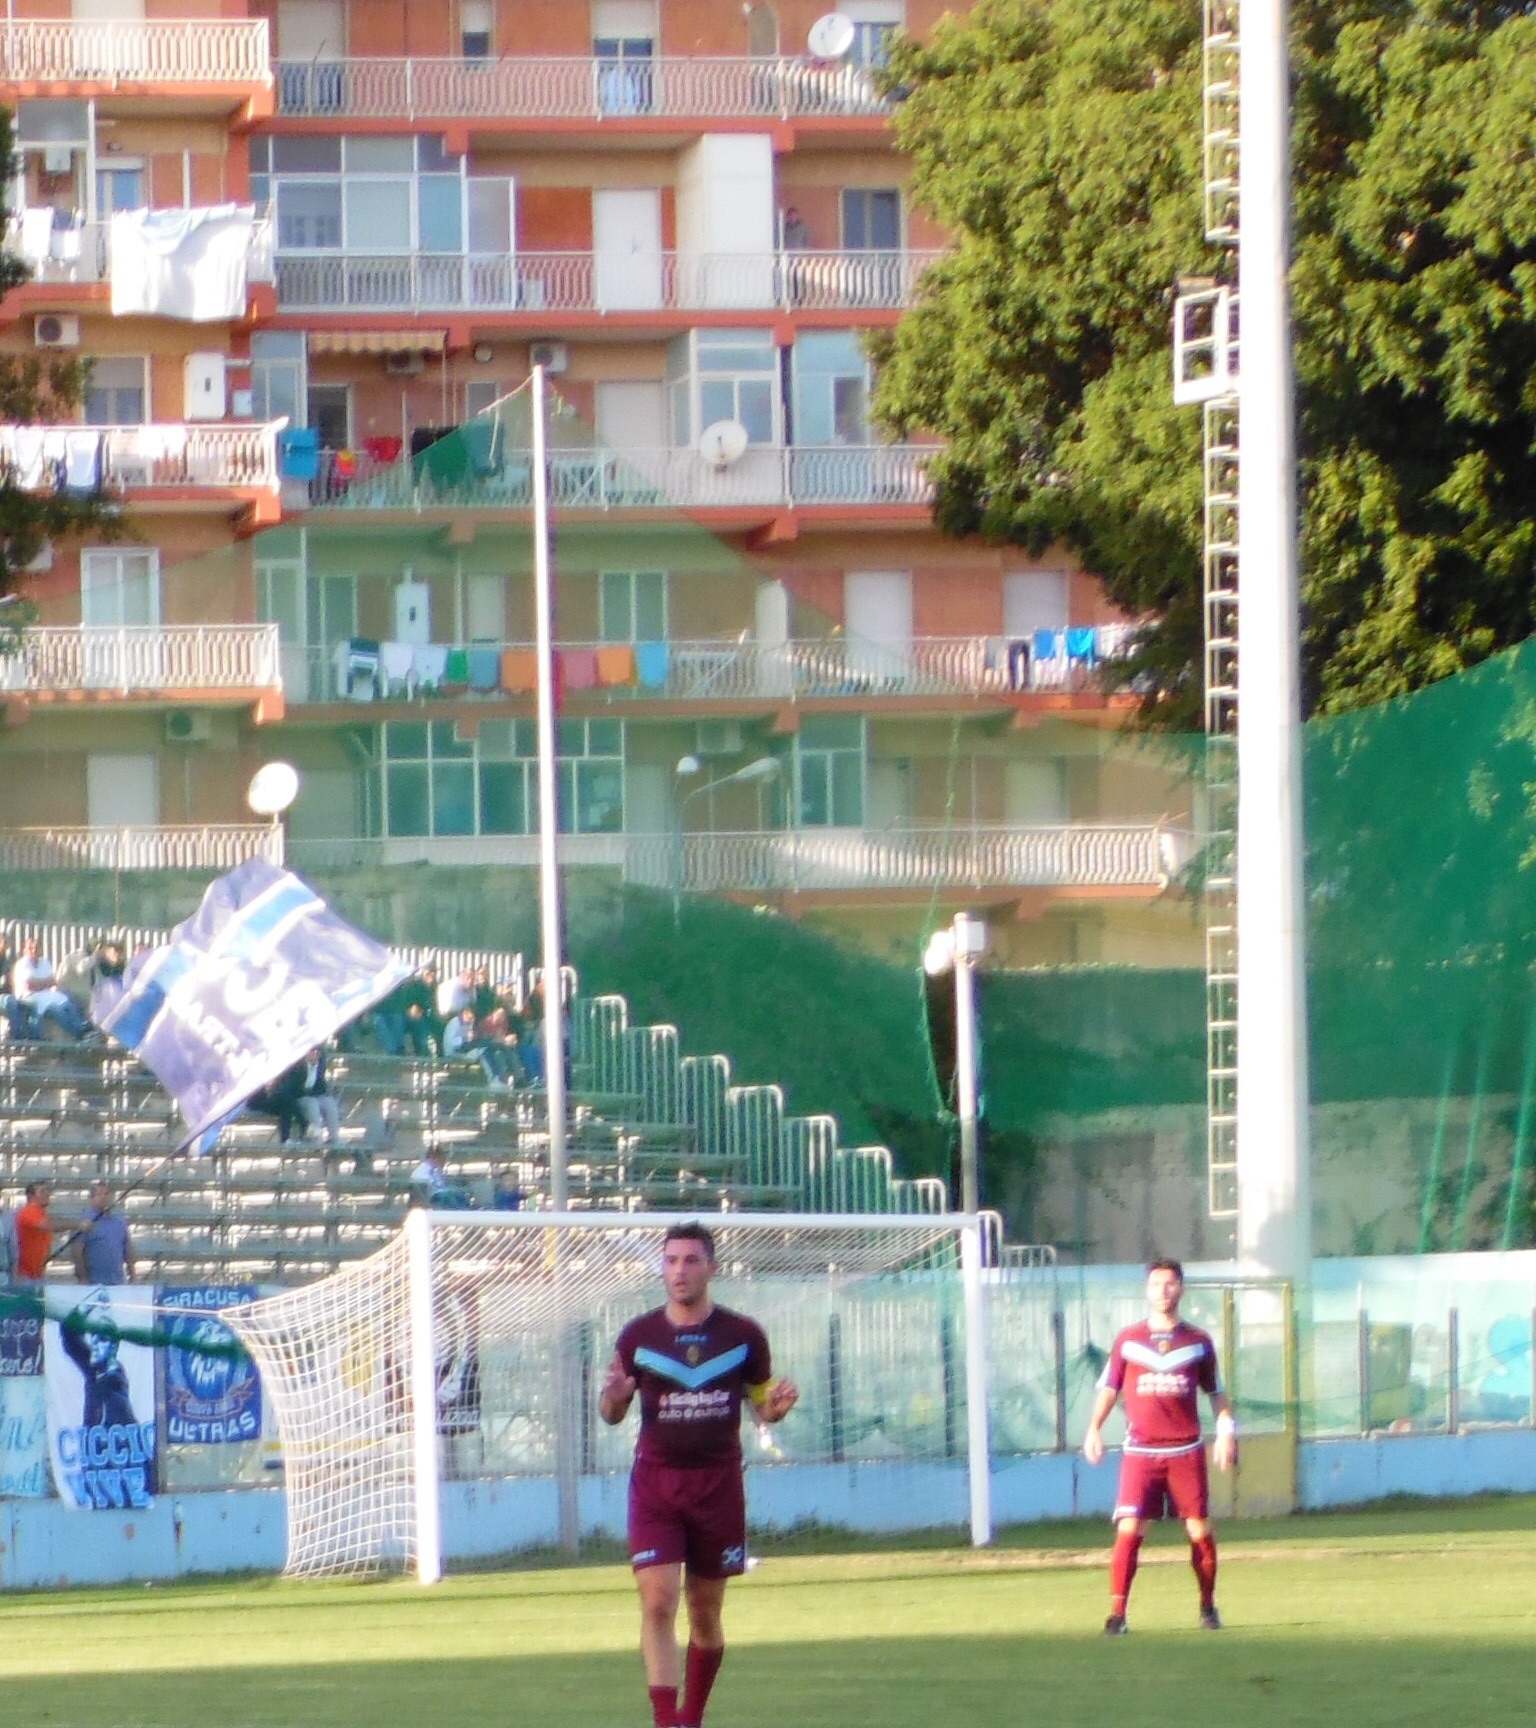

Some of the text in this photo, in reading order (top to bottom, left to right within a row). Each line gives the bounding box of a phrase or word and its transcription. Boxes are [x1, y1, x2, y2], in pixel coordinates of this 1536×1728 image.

[162, 1289, 252, 1309] SIRACUSA
[168, 1410, 256, 1442] ULTRAS
[62, 1467, 152, 1510] VIVE
